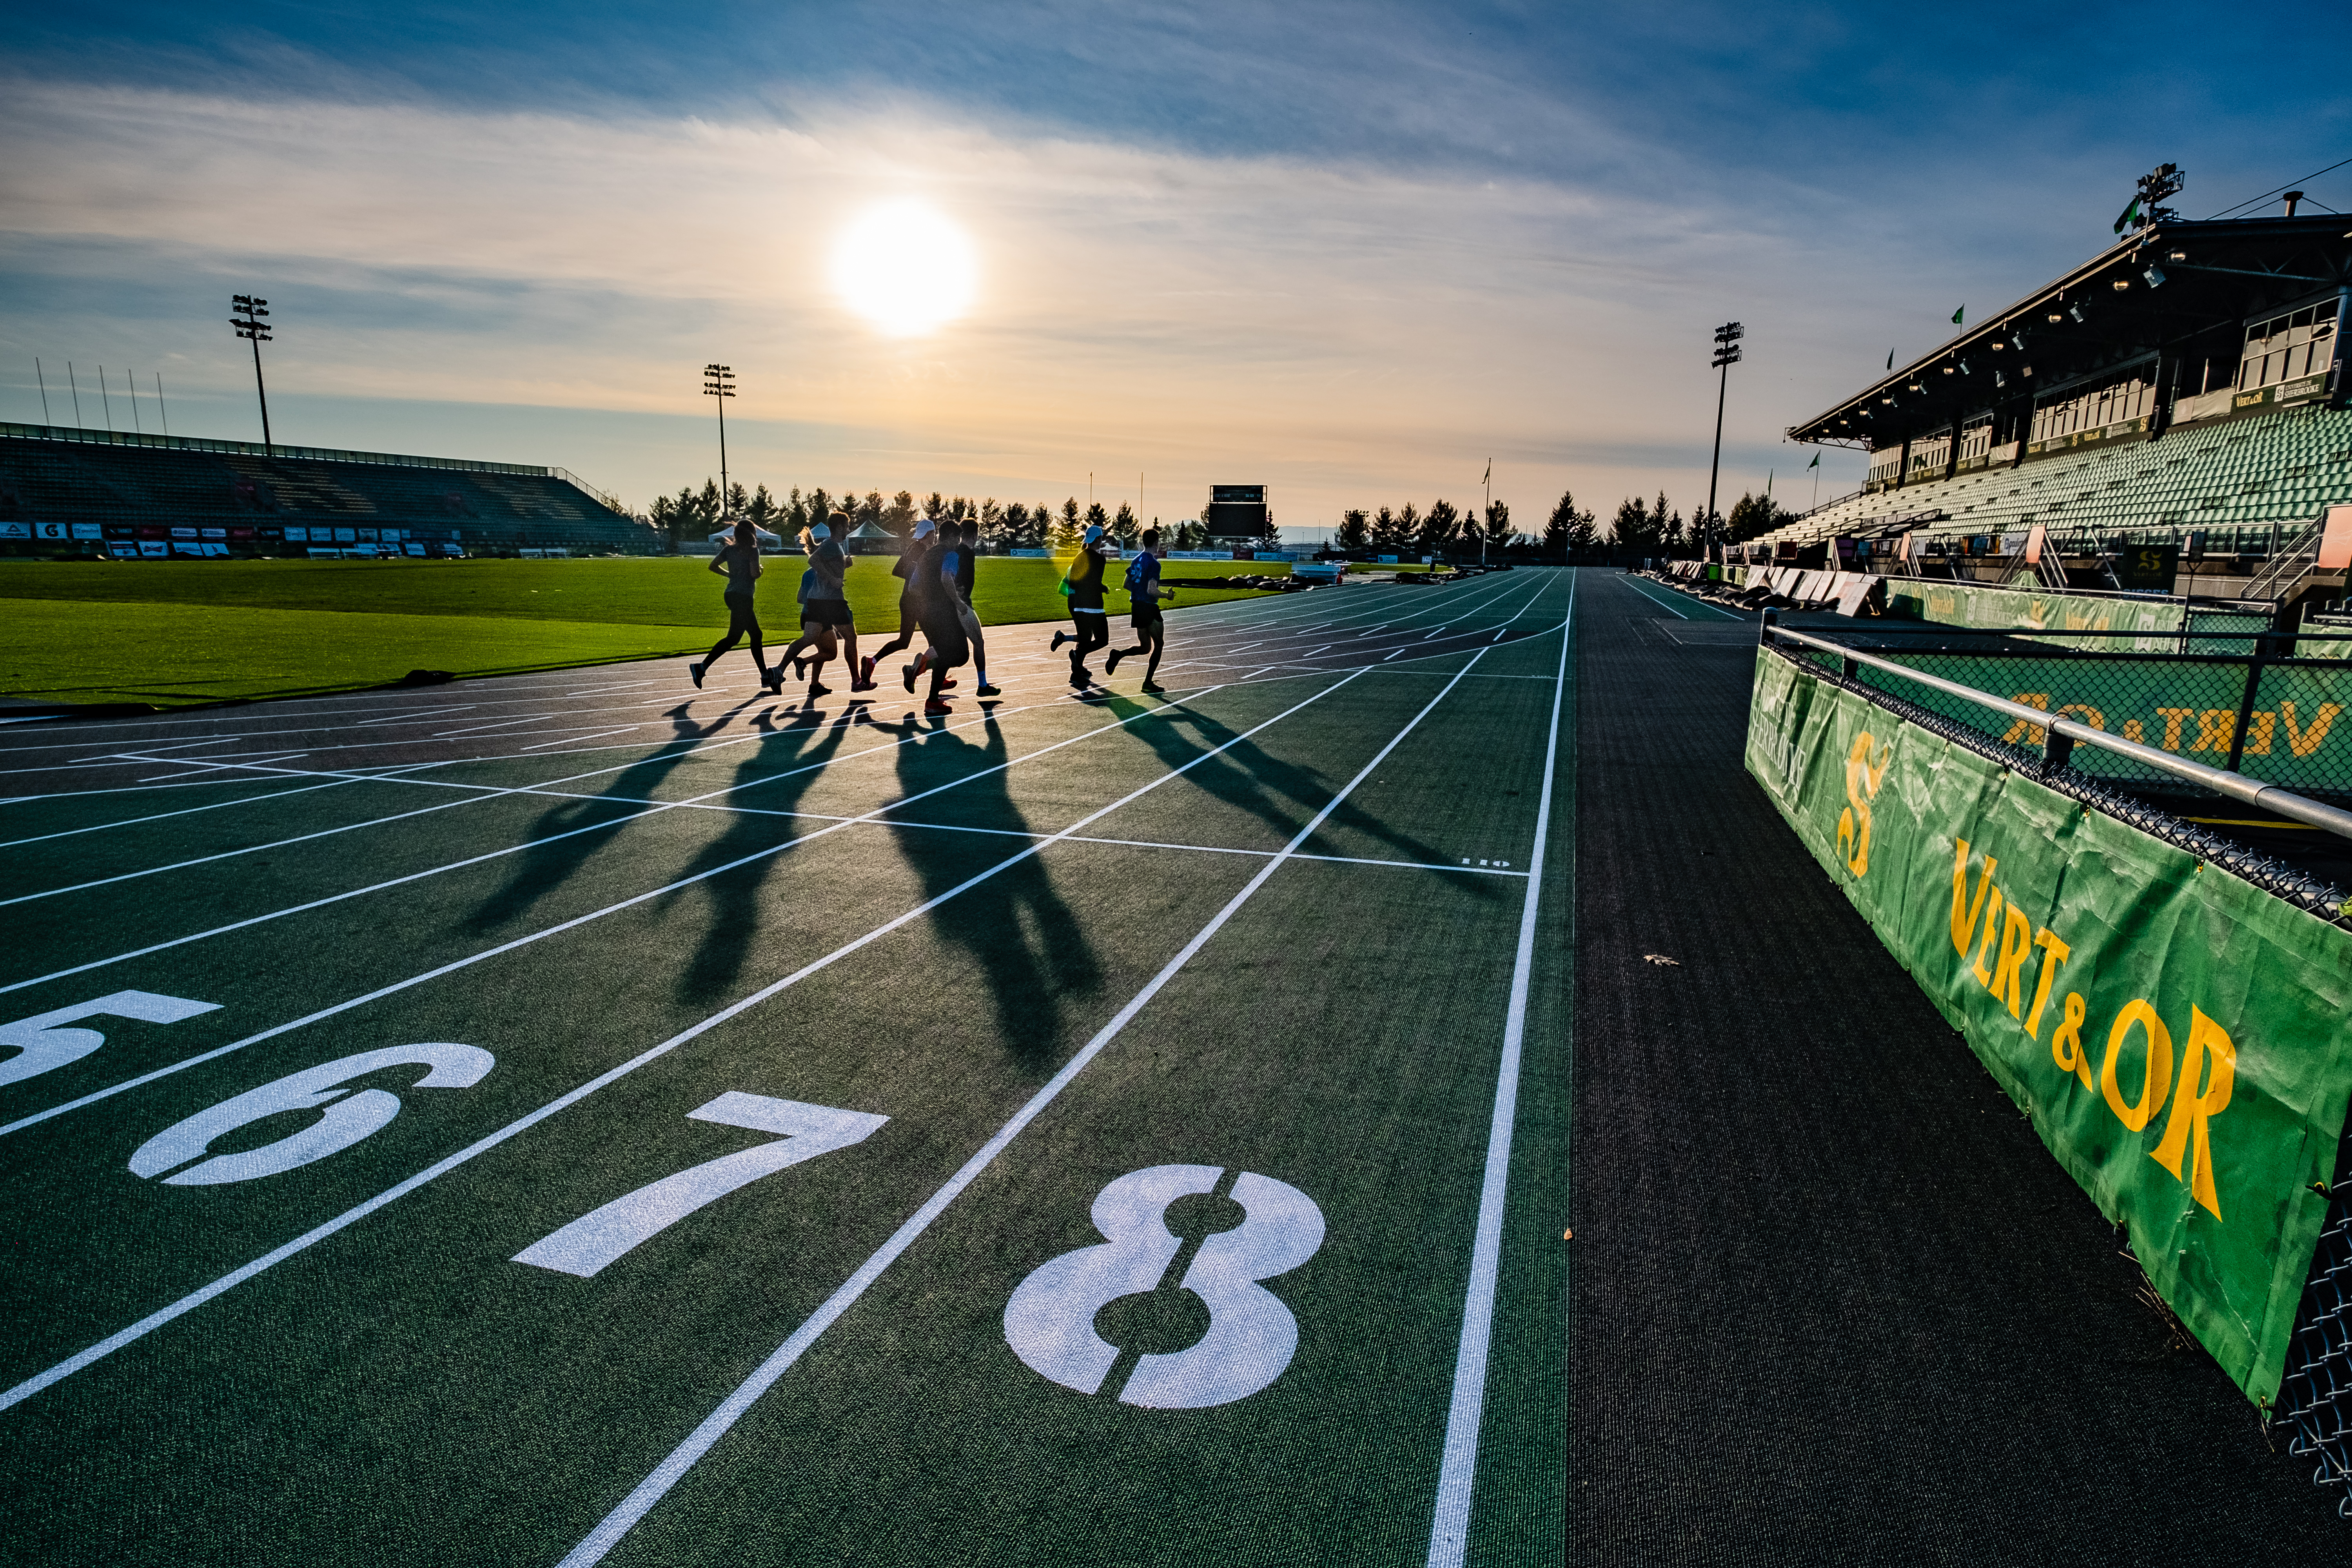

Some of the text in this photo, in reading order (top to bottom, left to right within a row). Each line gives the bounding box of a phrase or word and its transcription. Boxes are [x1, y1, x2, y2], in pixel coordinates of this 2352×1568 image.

[45, 524, 58, 537] G
[2138, 550, 2162, 570] S
[1837, 731, 1888, 878] S
[0, 989, 225, 1085] 5
[1950, 837, 2236, 1222] VERT & OR
[127, 1042, 495, 1185] 6
[510, 1090, 892, 1278] 7
[1004, 1164, 1326, 1410] 8
